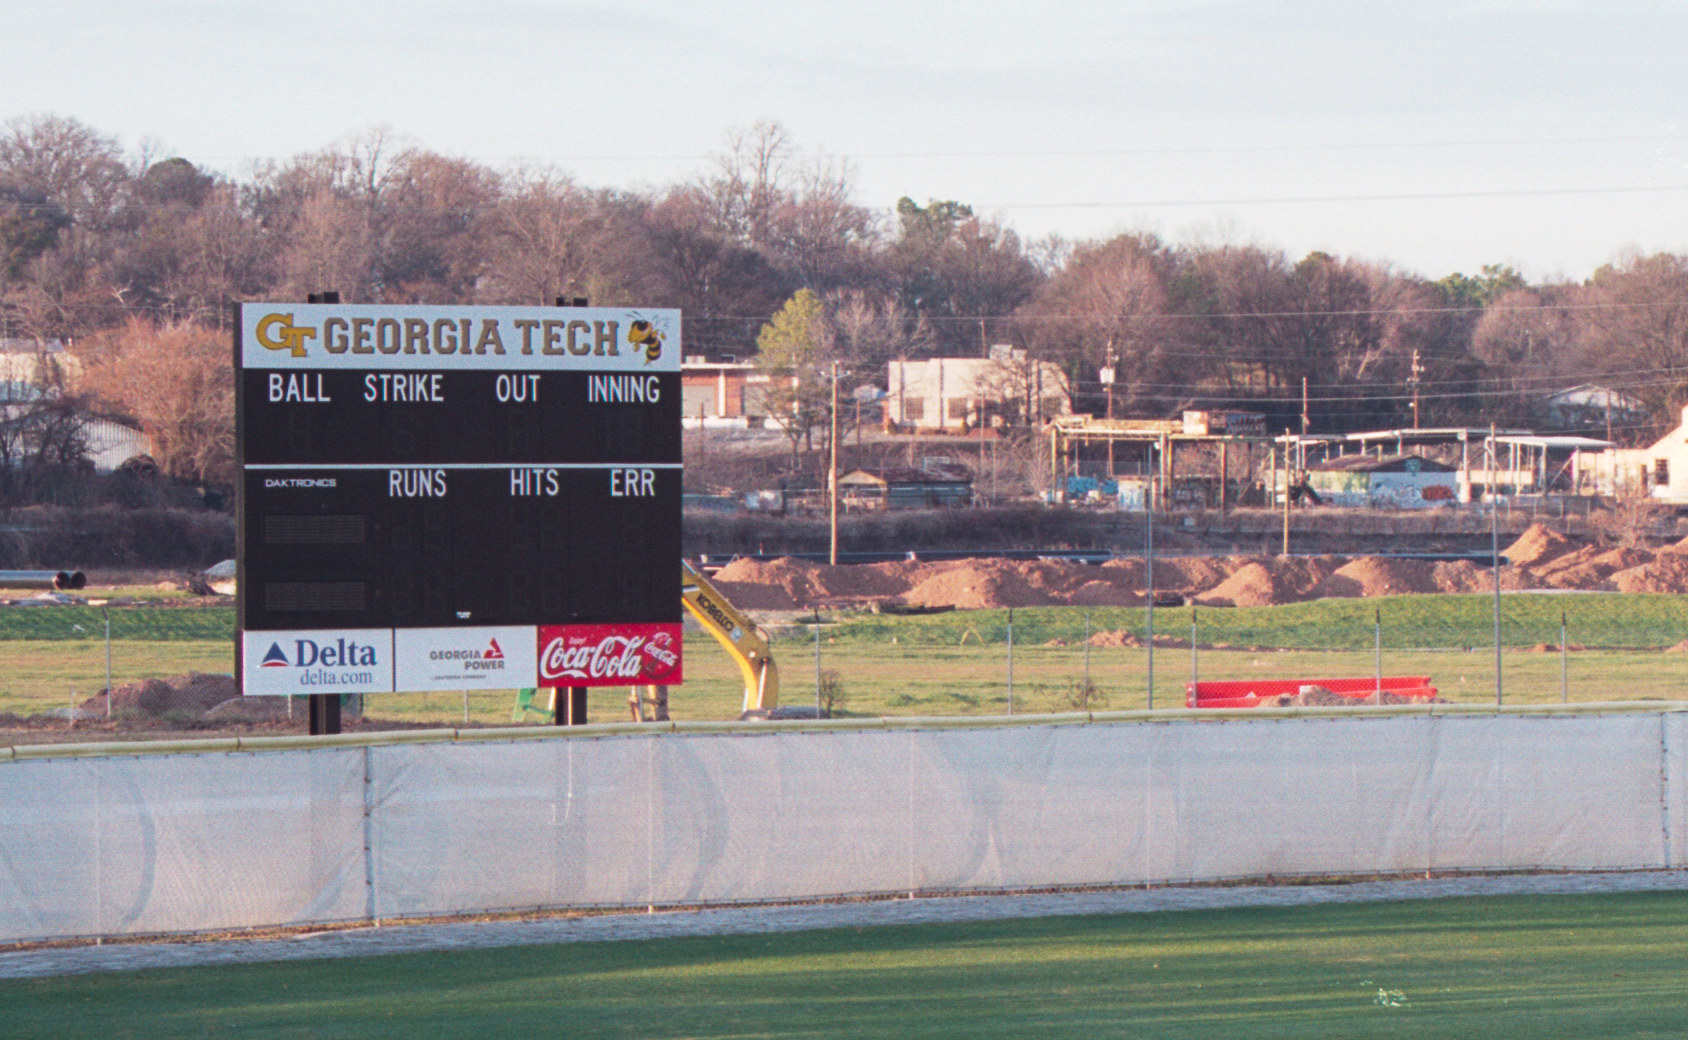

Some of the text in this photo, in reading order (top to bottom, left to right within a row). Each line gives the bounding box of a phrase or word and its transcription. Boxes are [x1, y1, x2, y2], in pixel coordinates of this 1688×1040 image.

[256, 313, 620, 358] GT GEORGIA TECH
[269, 373, 660, 403] BALL STRIKE OUT INNING
[264, 469, 655, 497] DAKTRONICS RUNS HITS ERR
[696, 593, 734, 632] KOBELCO
[295, 638, 377, 667] Delta
[429, 650, 481, 660] GEORGIA
[464, 660, 504, 670] POWER
[540, 635, 645, 679] Coca-Cola
[300, 669, 373, 686] delta.com
